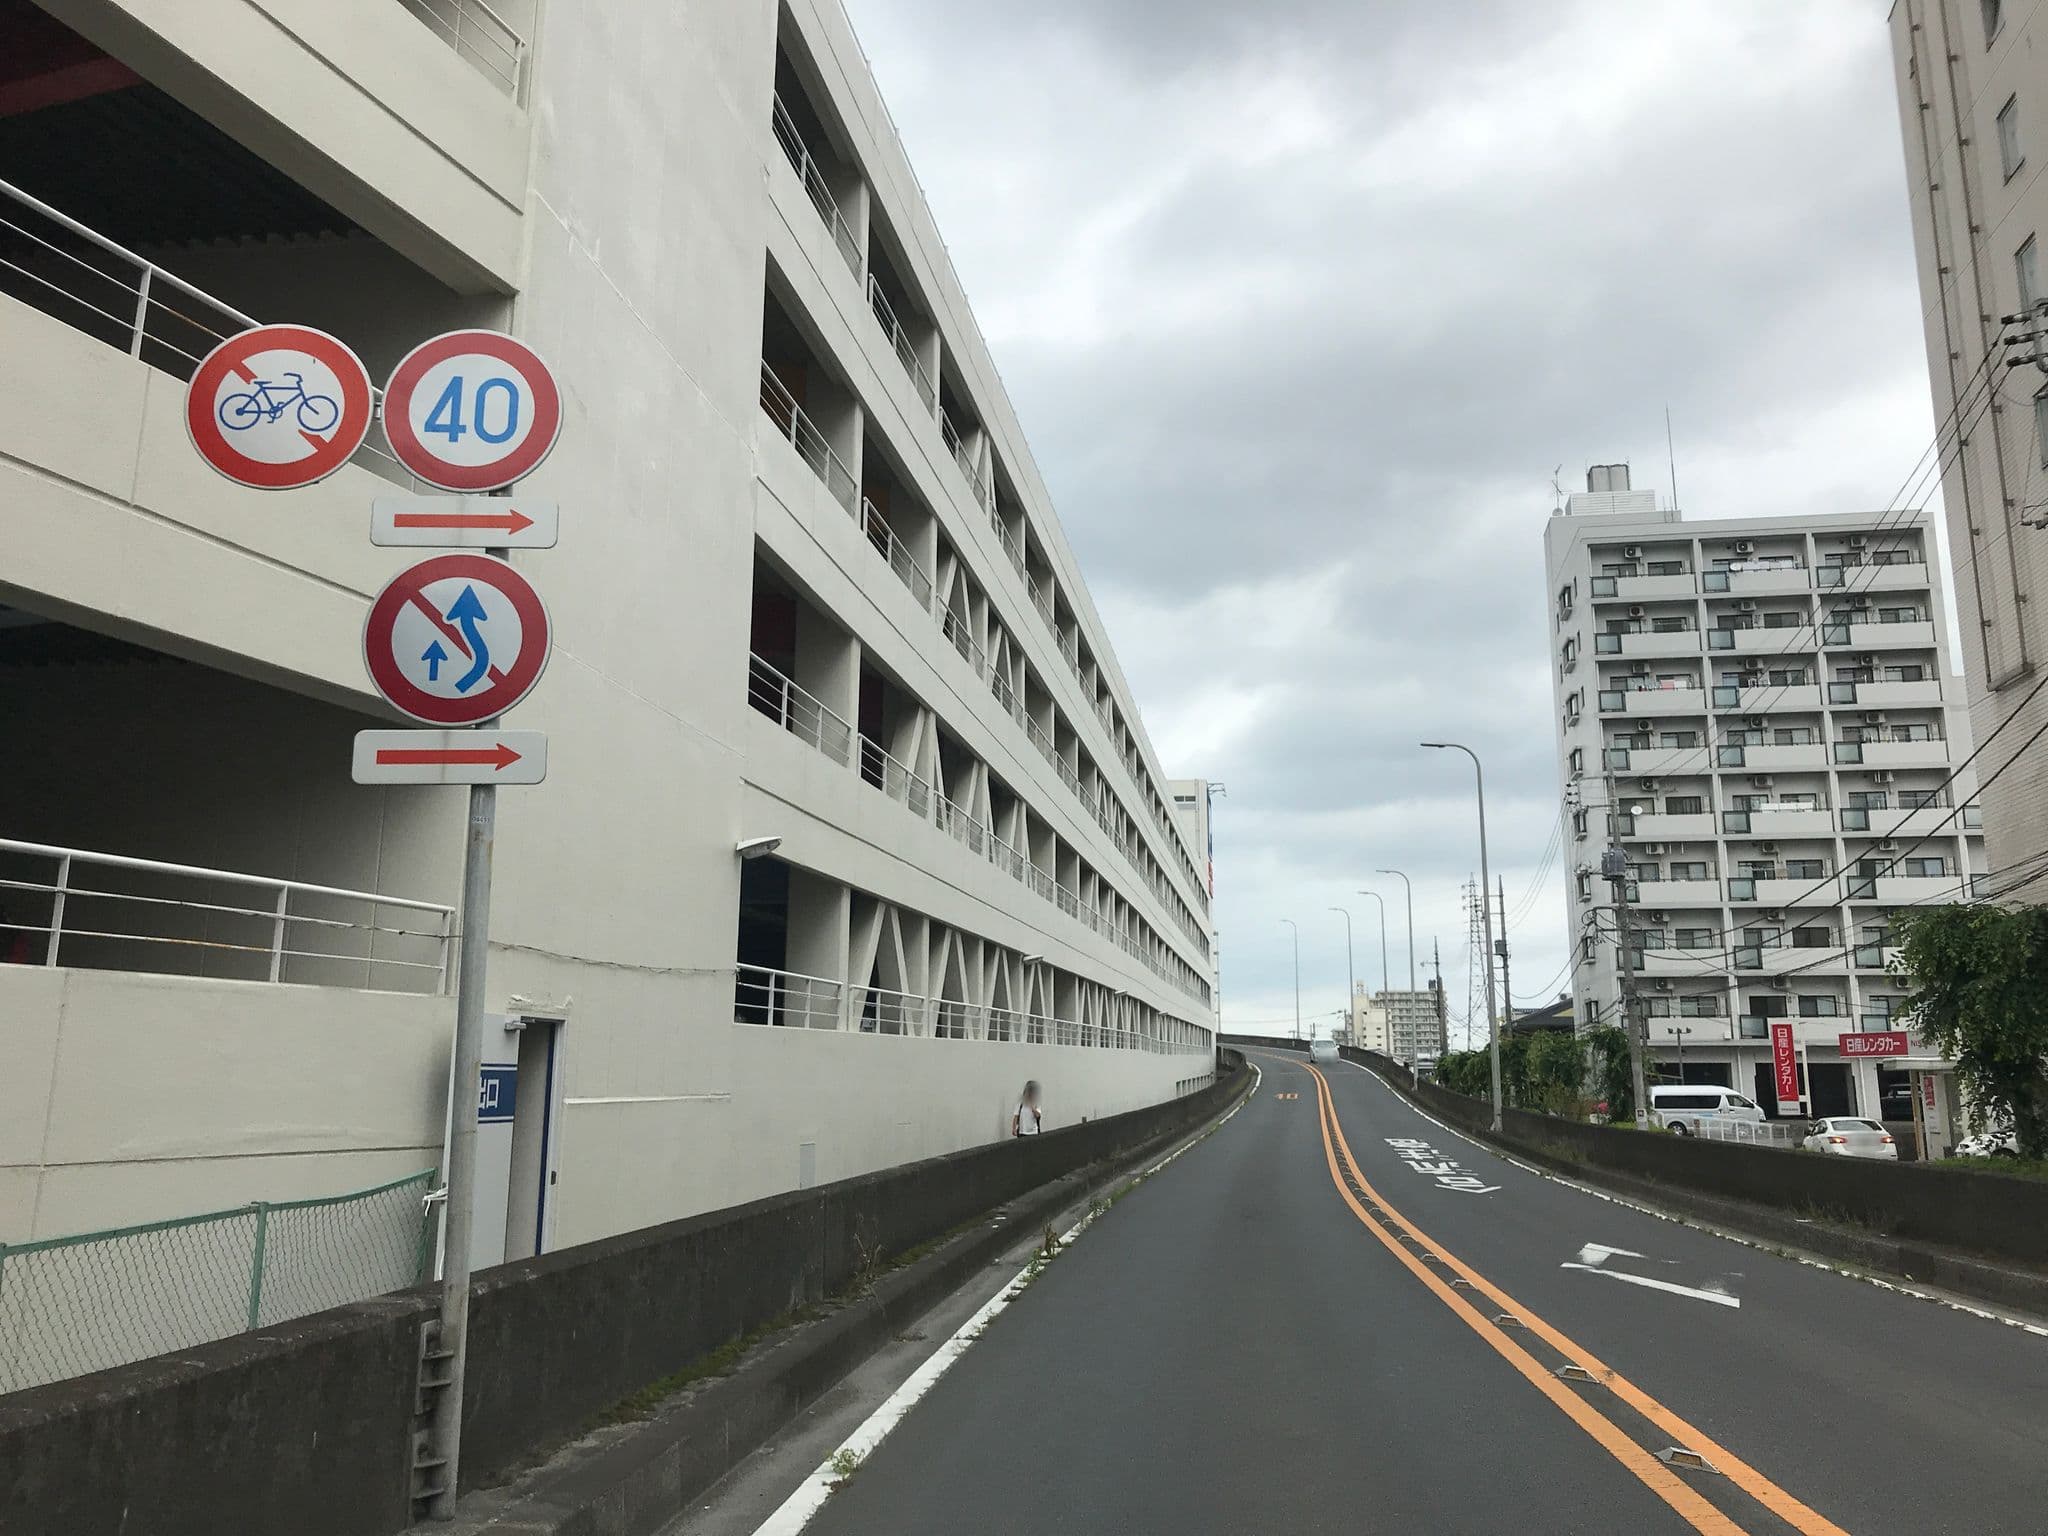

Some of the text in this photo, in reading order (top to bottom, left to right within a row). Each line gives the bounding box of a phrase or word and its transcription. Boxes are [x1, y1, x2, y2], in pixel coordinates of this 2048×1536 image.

[424, 376, 519, 444] 40
[1777, 1028, 1792, 1093] 日産レンタカー
[1846, 1037, 1900, 1053] 日産レンタカー
